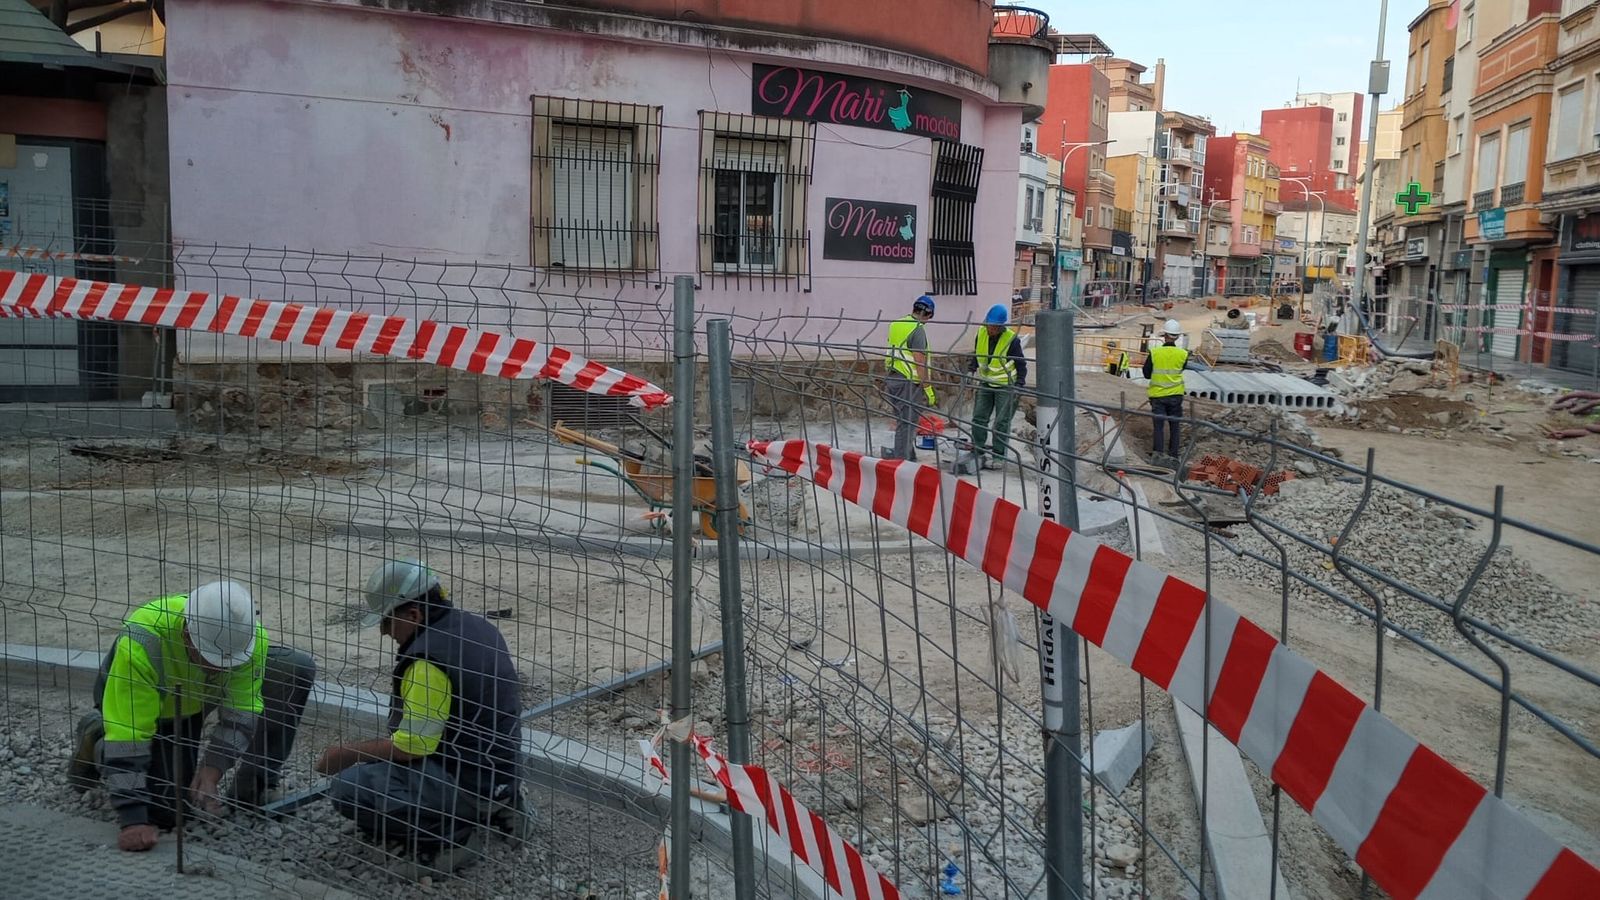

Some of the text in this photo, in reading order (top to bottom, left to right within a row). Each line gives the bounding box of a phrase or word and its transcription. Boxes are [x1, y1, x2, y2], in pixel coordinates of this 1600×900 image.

[759, 67, 960, 138] Mari modas
[829, 201, 913, 258] Mari modas
[1041, 484, 1055, 521] jos
